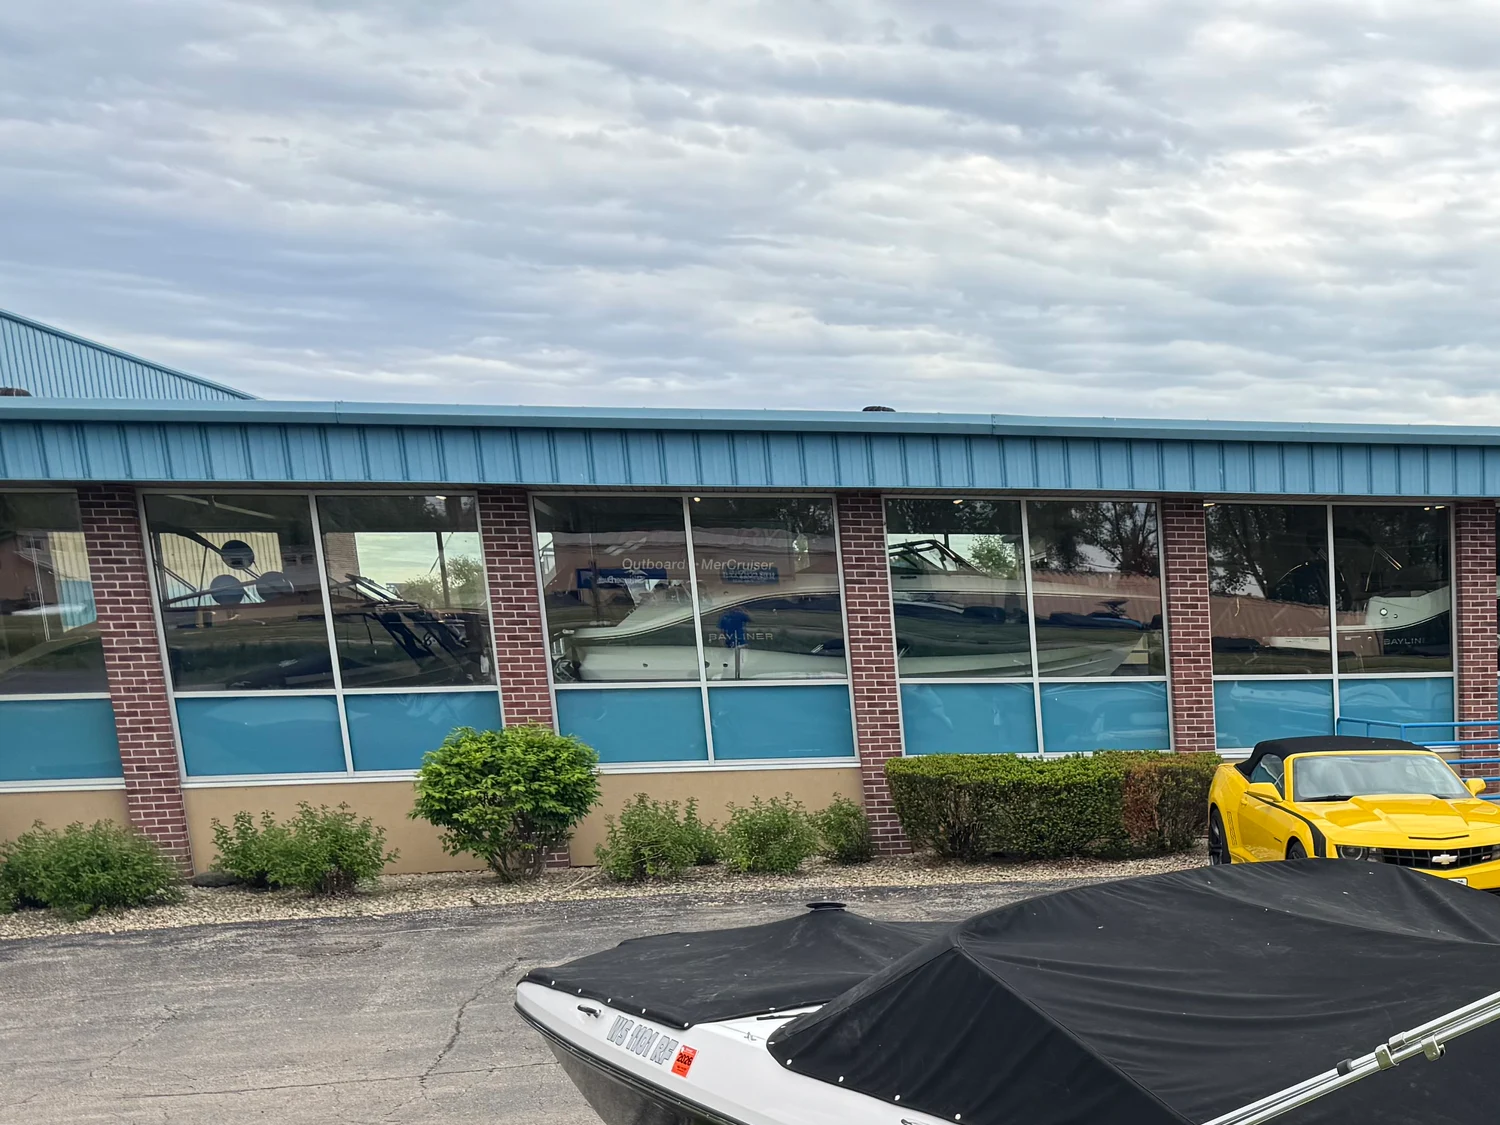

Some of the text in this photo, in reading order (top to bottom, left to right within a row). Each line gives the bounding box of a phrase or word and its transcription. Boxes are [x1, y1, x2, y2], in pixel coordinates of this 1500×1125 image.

[622, 557, 774, 571] Outboard MerCruiser
[606, 1014, 635, 1047] WS
[649, 1035, 680, 1065] RF
[676, 1052, 693, 1067] 2026
